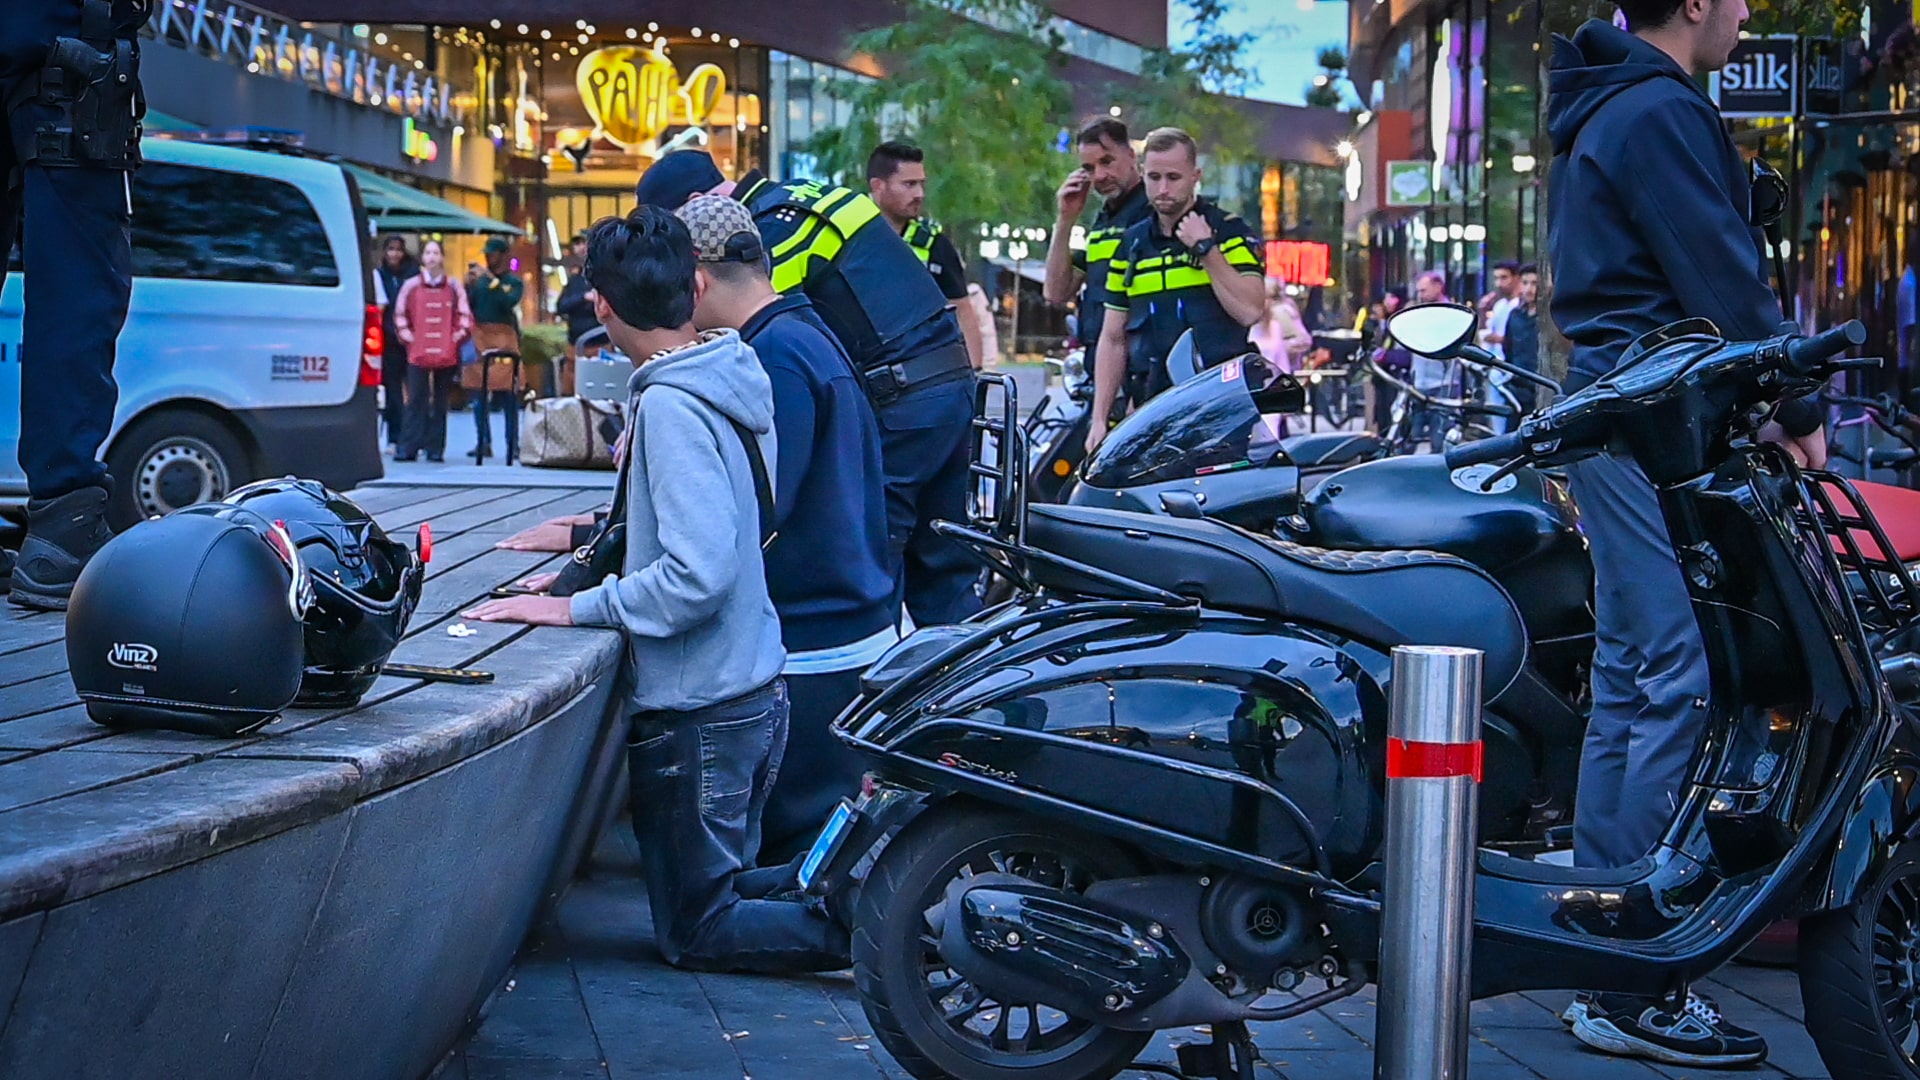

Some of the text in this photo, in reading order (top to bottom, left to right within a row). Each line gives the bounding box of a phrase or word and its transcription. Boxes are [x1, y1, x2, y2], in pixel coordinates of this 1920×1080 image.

[1721, 53, 1790, 90] silk
[303, 356, 329, 371] 112
[113, 643, 149, 662] Vinz
